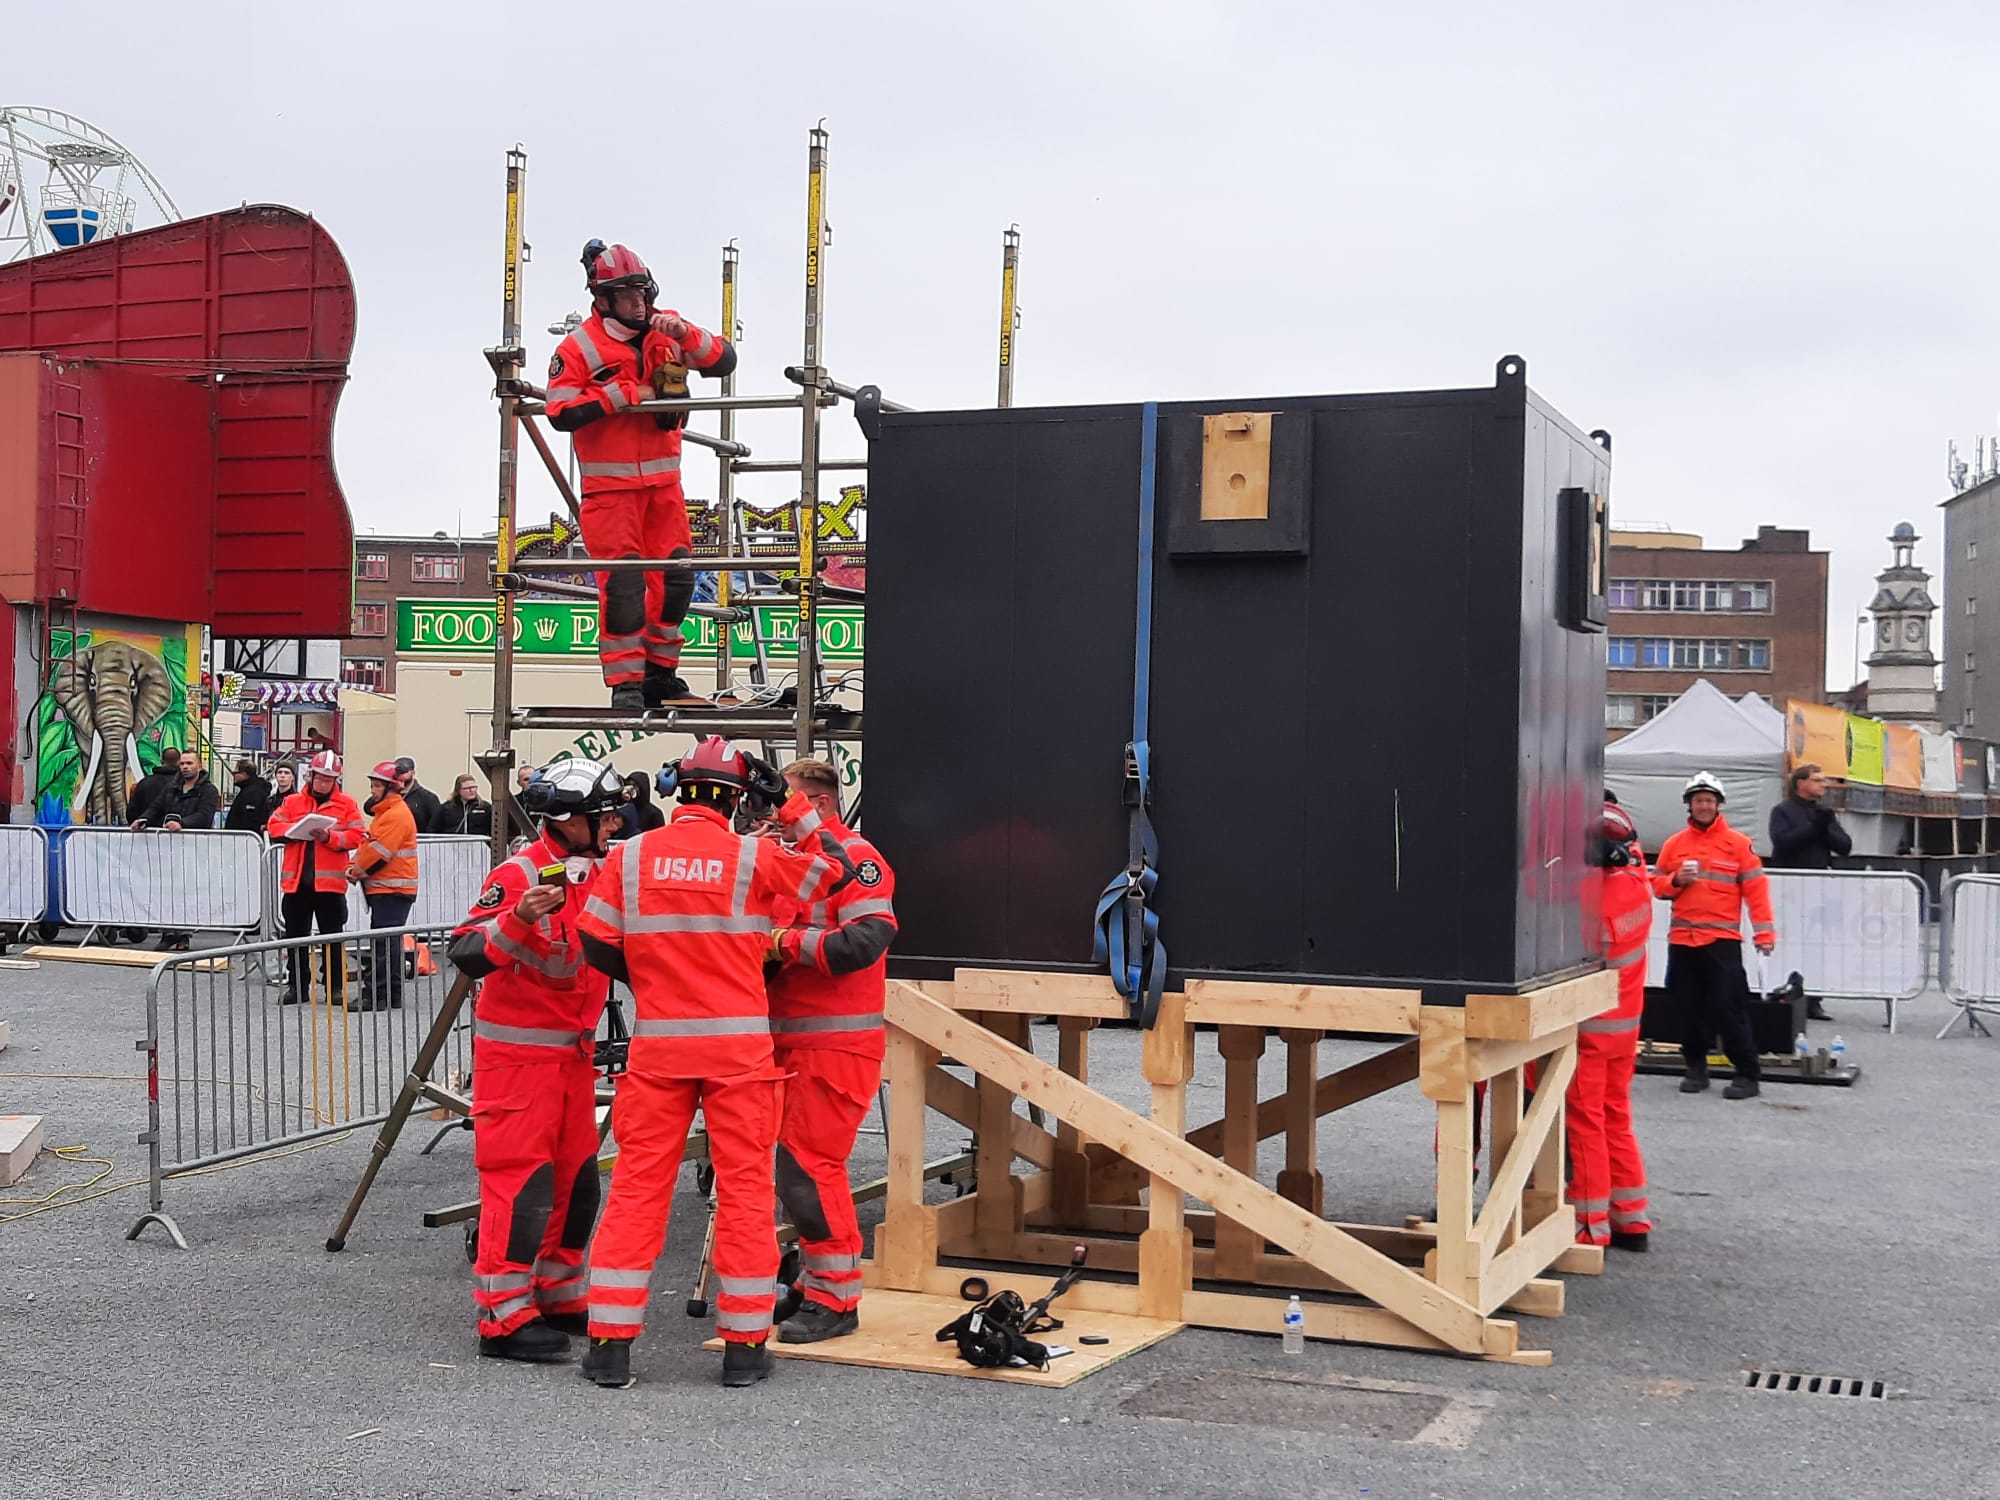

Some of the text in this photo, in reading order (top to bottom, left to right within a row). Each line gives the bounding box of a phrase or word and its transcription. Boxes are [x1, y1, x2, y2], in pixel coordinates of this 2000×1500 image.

[505, 263, 515, 301] LOBO
[807, 247, 817, 286] LOBO
[1001, 332, 1009, 365] LOBO
[497, 591, 506, 624] OBO
[653, 856, 724, 885] USAR
